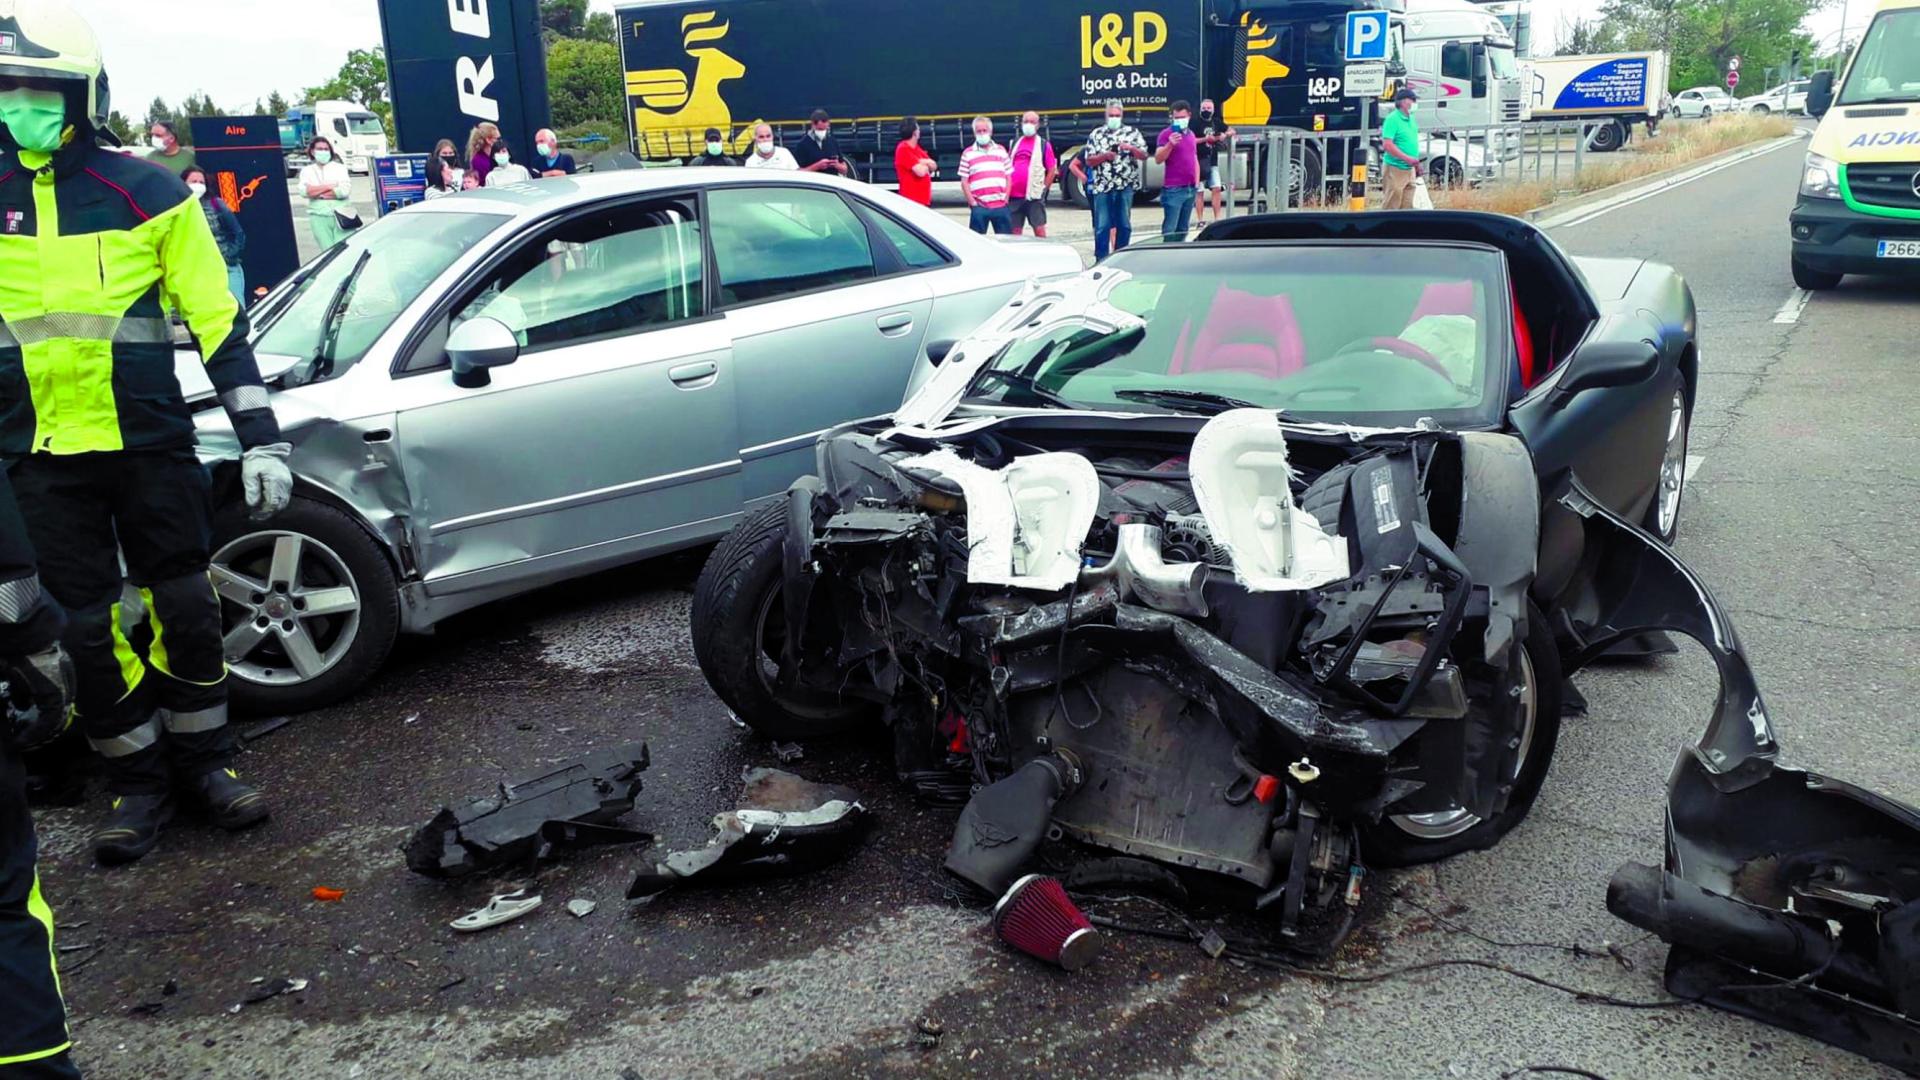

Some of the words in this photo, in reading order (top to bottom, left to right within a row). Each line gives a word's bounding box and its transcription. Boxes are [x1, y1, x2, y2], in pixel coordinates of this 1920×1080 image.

[1081, 11, 1168, 68] I&P
[1353, 16, 1380, 55] P
[1081, 75, 1113, 94] Igoa
[1115, 73, 1127, 88] &
[1130, 72, 1168, 88] Patxi
[1308, 77, 1341, 97] I&P
[225, 125, 246, 135] Aire
